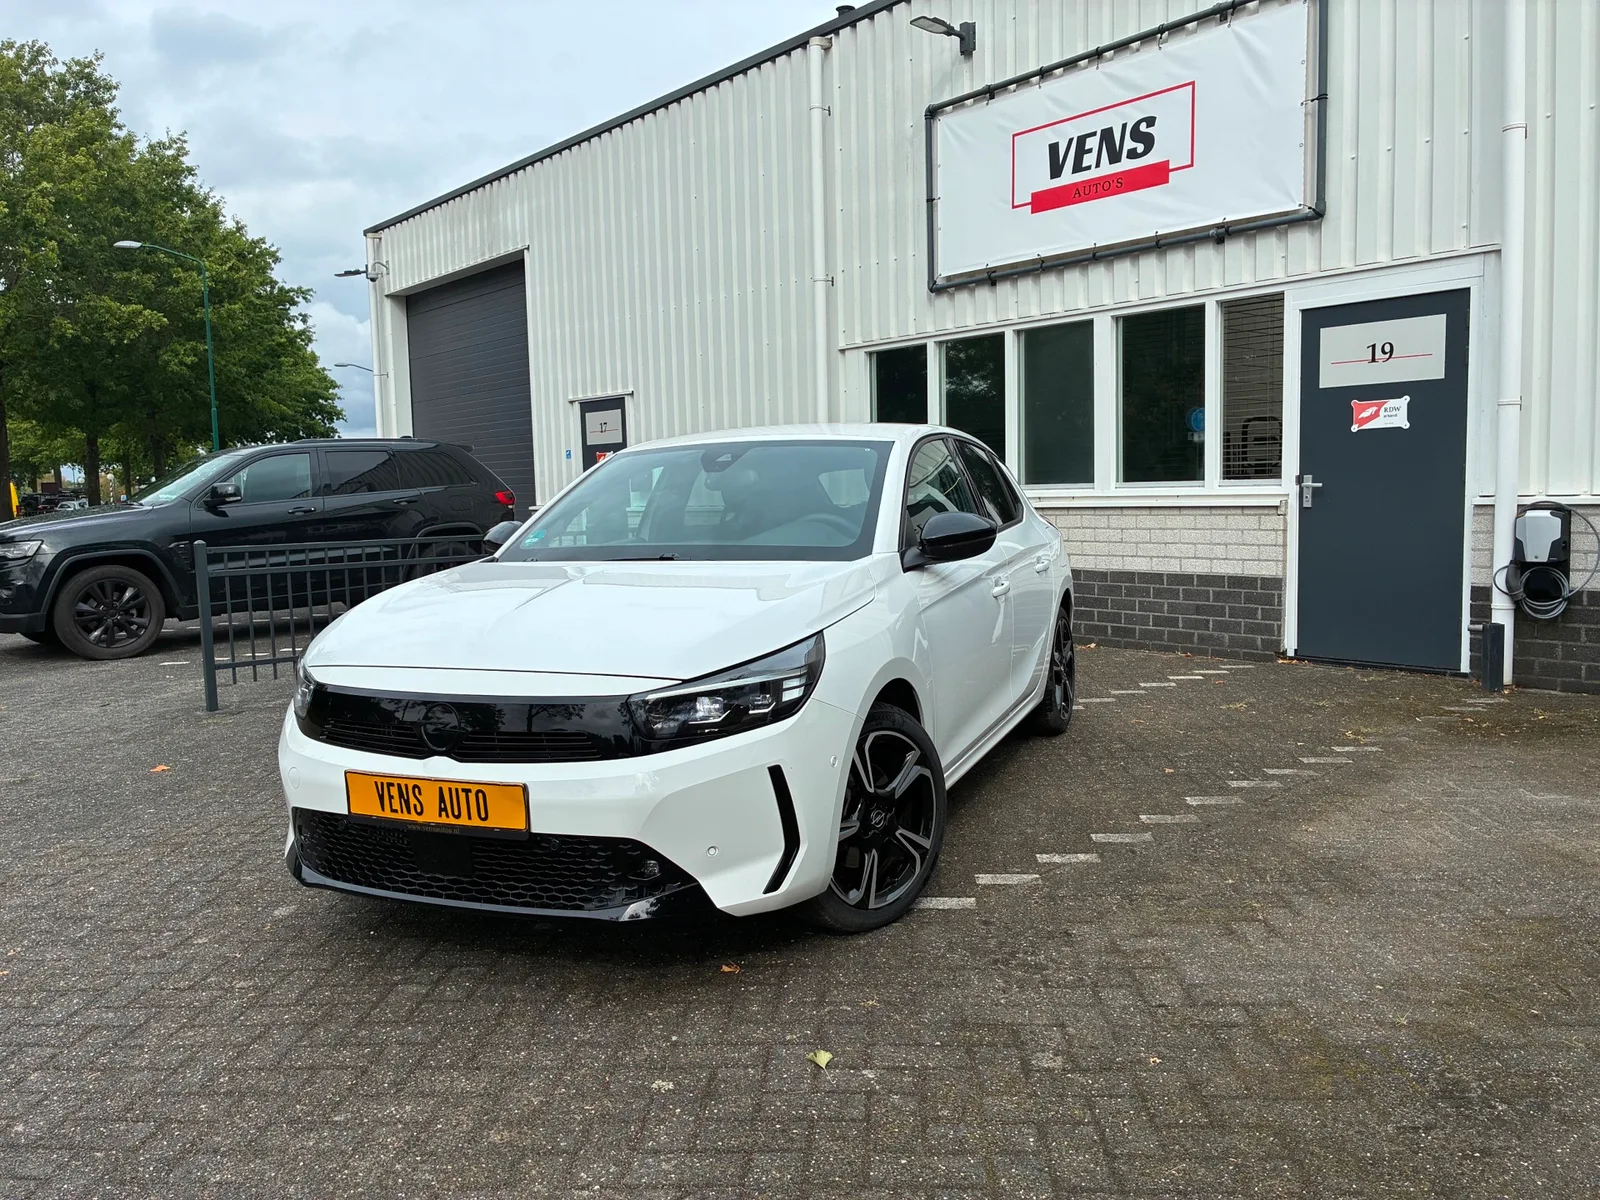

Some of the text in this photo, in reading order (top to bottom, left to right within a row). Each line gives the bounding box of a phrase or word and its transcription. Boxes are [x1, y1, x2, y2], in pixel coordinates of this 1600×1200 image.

[1048, 115, 1157, 180] VENS
[1072, 177, 1124, 199] AUTO'S
[1366, 341, 1394, 364] 19
[599, 422, 607, 433] 17
[374, 780, 489, 822] VENS AUTO
